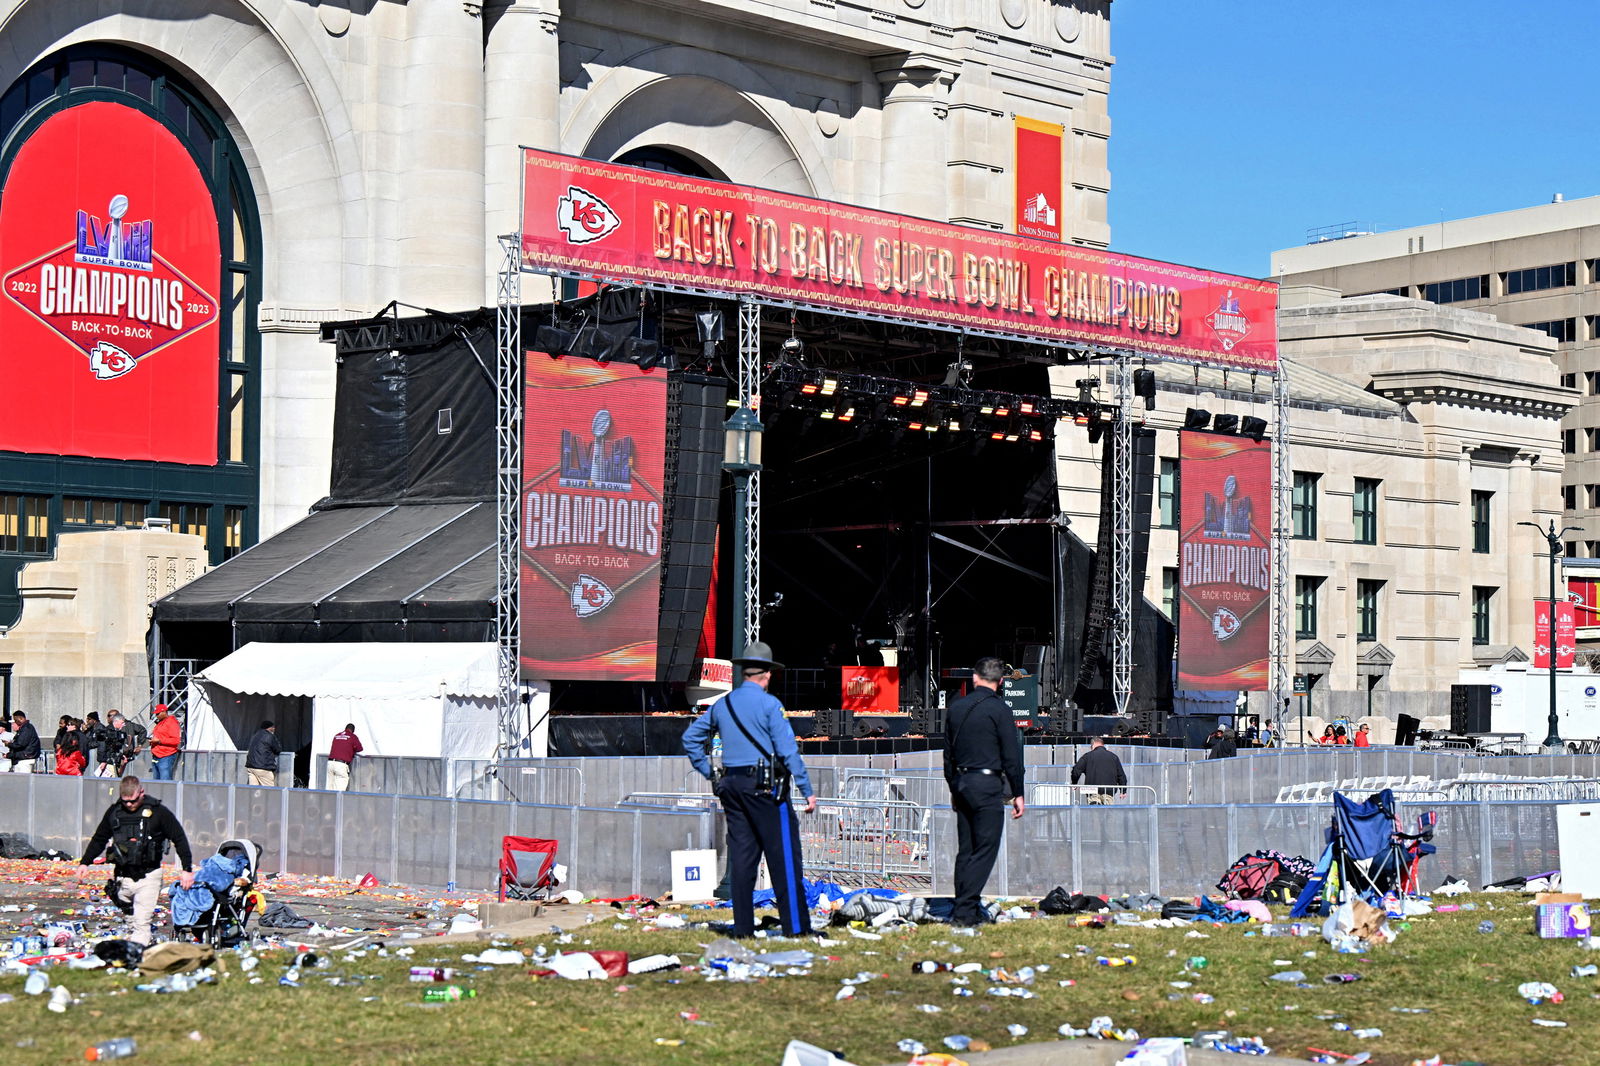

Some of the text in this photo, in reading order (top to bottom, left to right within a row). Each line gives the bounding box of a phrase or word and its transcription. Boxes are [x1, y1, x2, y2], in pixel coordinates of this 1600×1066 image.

[1018, 224, 1059, 239] UNION STATION
[82, 255, 147, 270] SUPER BOWL
[12, 281, 37, 293] 2022
[40, 263, 183, 330] CHAMPIONS
[874, 235, 957, 301] SUPER
[962, 251, 1034, 314] BOWL
[1044, 265, 1181, 336] CHAMPIONS
[187, 303, 209, 314] 2023
[101, 350, 126, 372] KC
[566, 480, 626, 491] SUPER BOWL
[525, 491, 659, 555] CHAMPIONS
[1183, 542, 1269, 591] CHAMPIONS
[582, 584, 605, 607] KC
